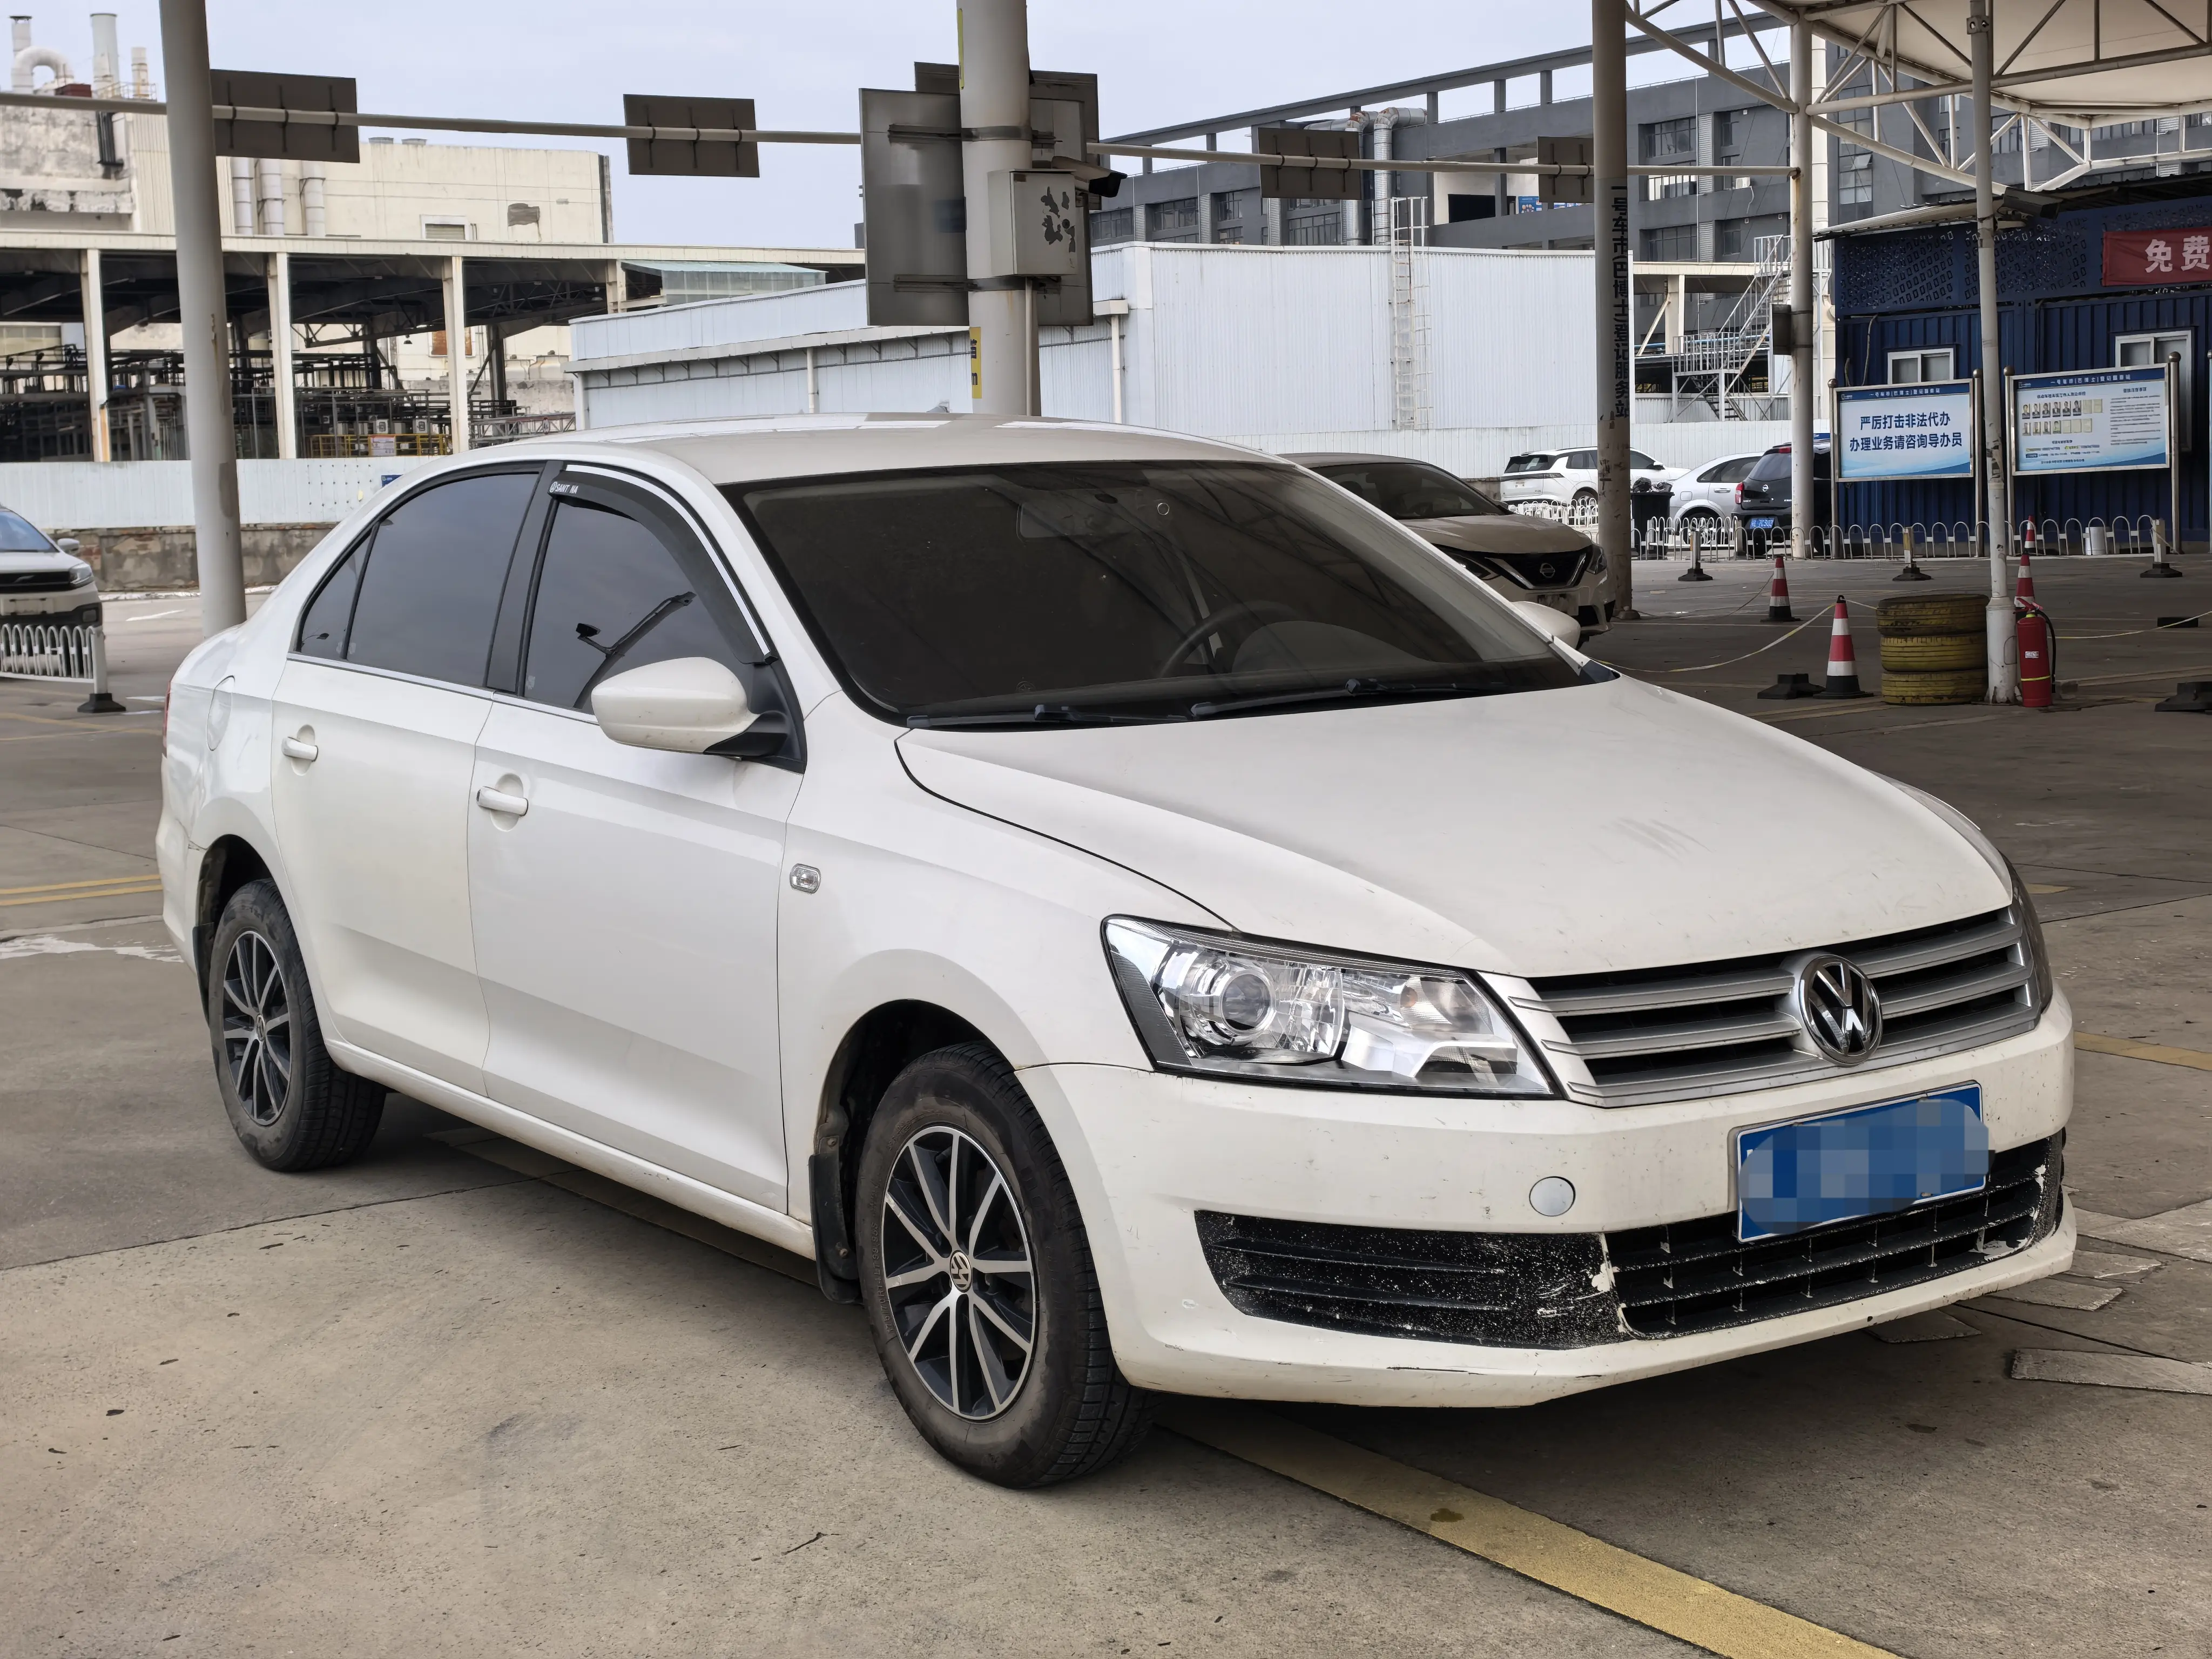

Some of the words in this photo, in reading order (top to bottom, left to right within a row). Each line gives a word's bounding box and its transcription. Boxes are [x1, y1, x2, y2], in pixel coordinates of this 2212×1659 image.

[2145, 235, 2210, 273] 免费
[1860, 411, 1951, 430] 严厉打击非法代办
[1850, 432, 1962, 452] 办理业务请咨询导办员
